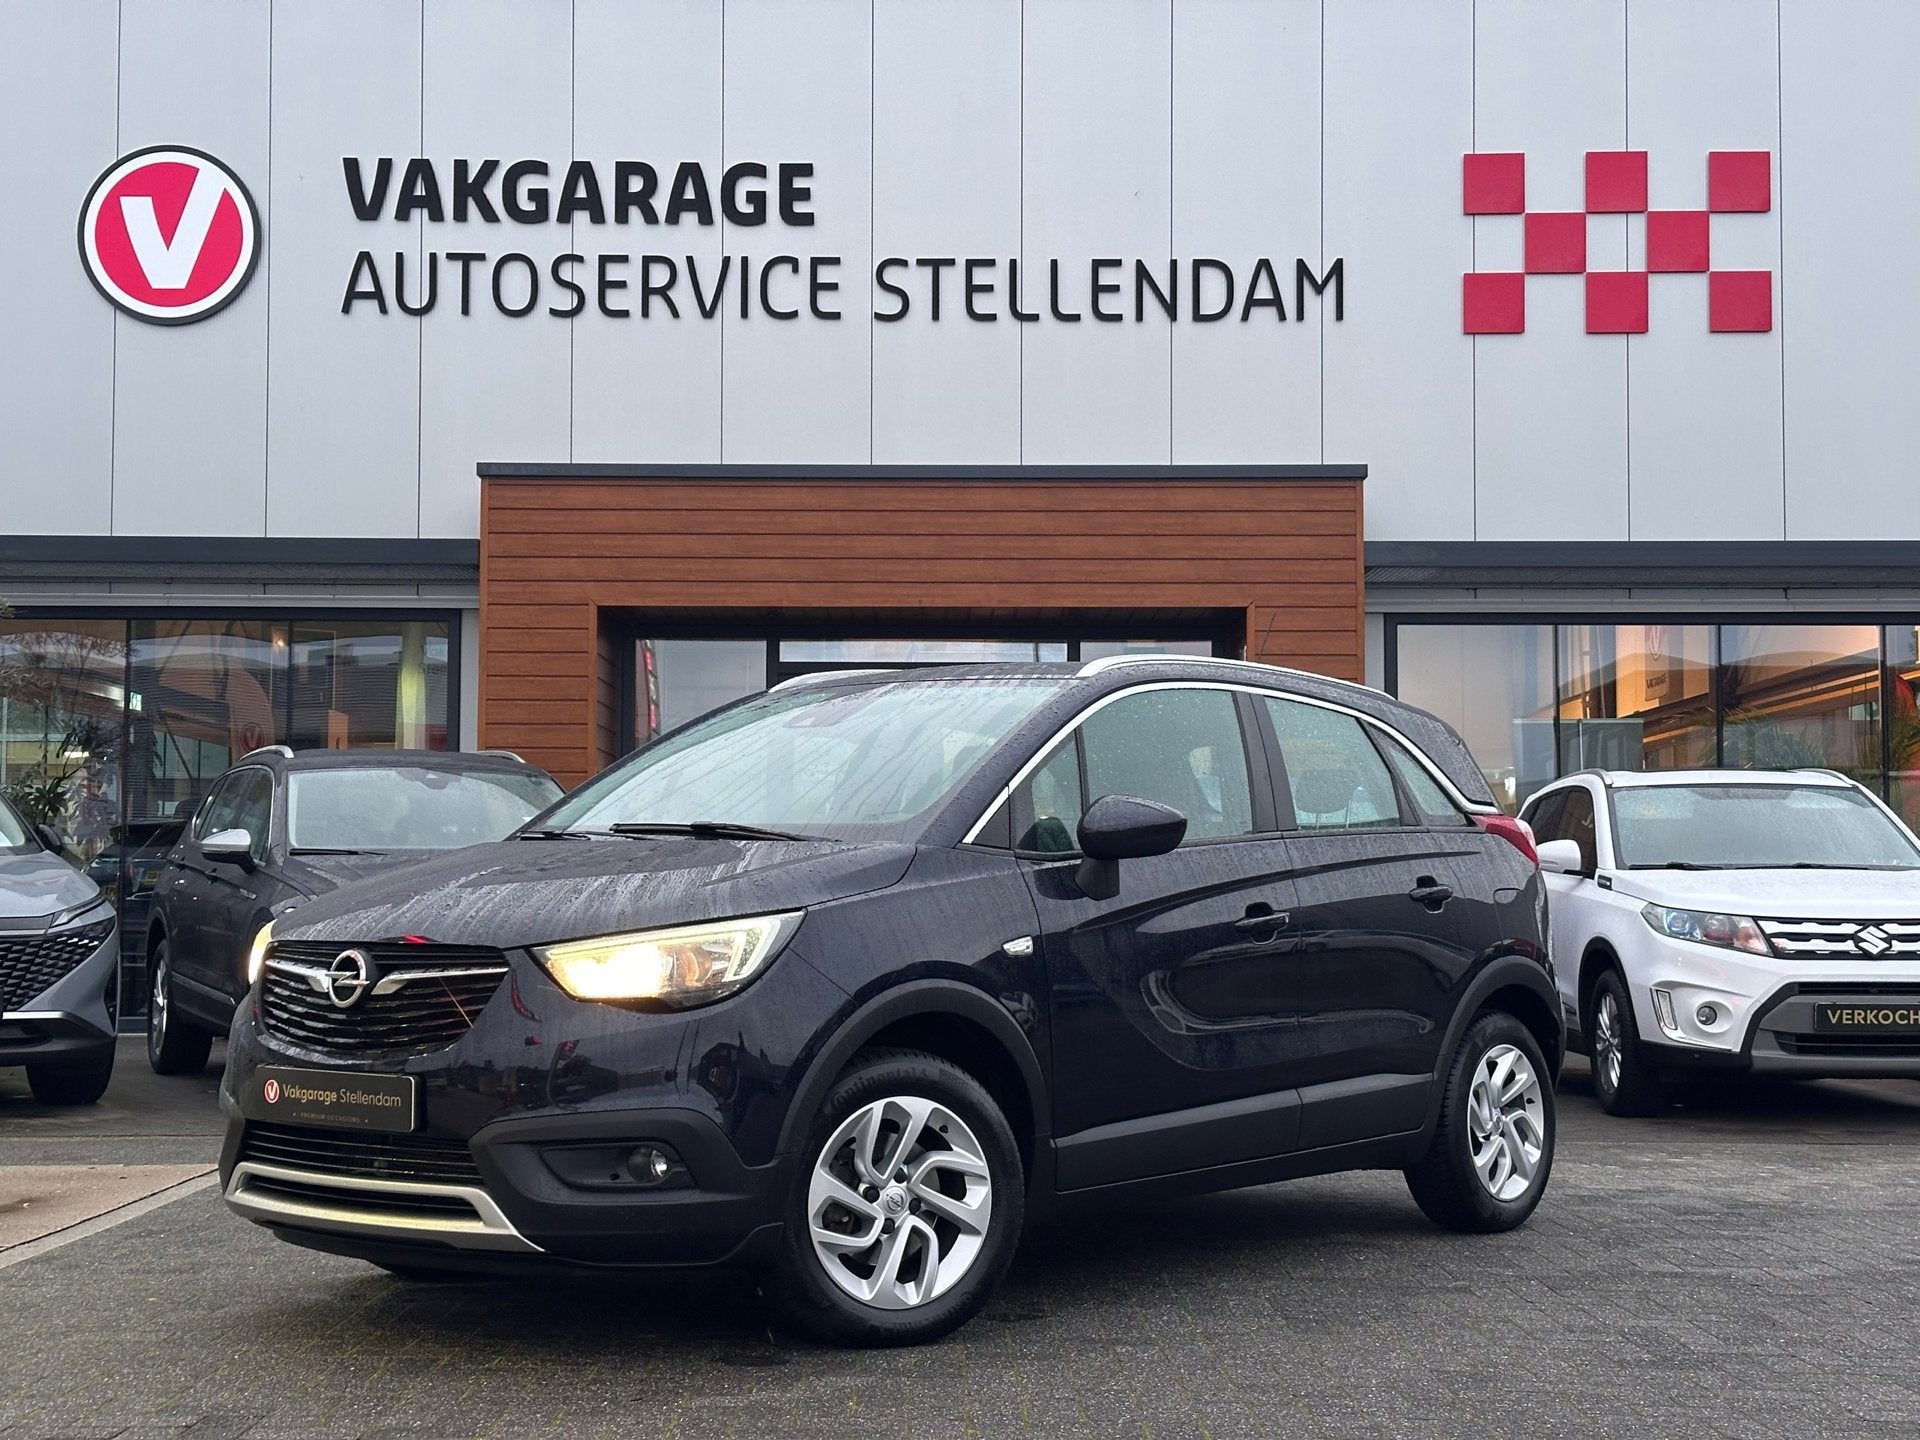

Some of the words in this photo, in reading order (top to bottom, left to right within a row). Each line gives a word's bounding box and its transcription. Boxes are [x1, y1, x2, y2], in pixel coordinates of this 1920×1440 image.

[342, 157, 815, 227] VAKGARAGE
[341, 250, 842, 321] AUTOSERVICE
[874, 257, 1344, 323] STELLENDAM
[282, 1083, 337, 1105] Vakgarage
[340, 1088, 402, 1107] Stellendam
